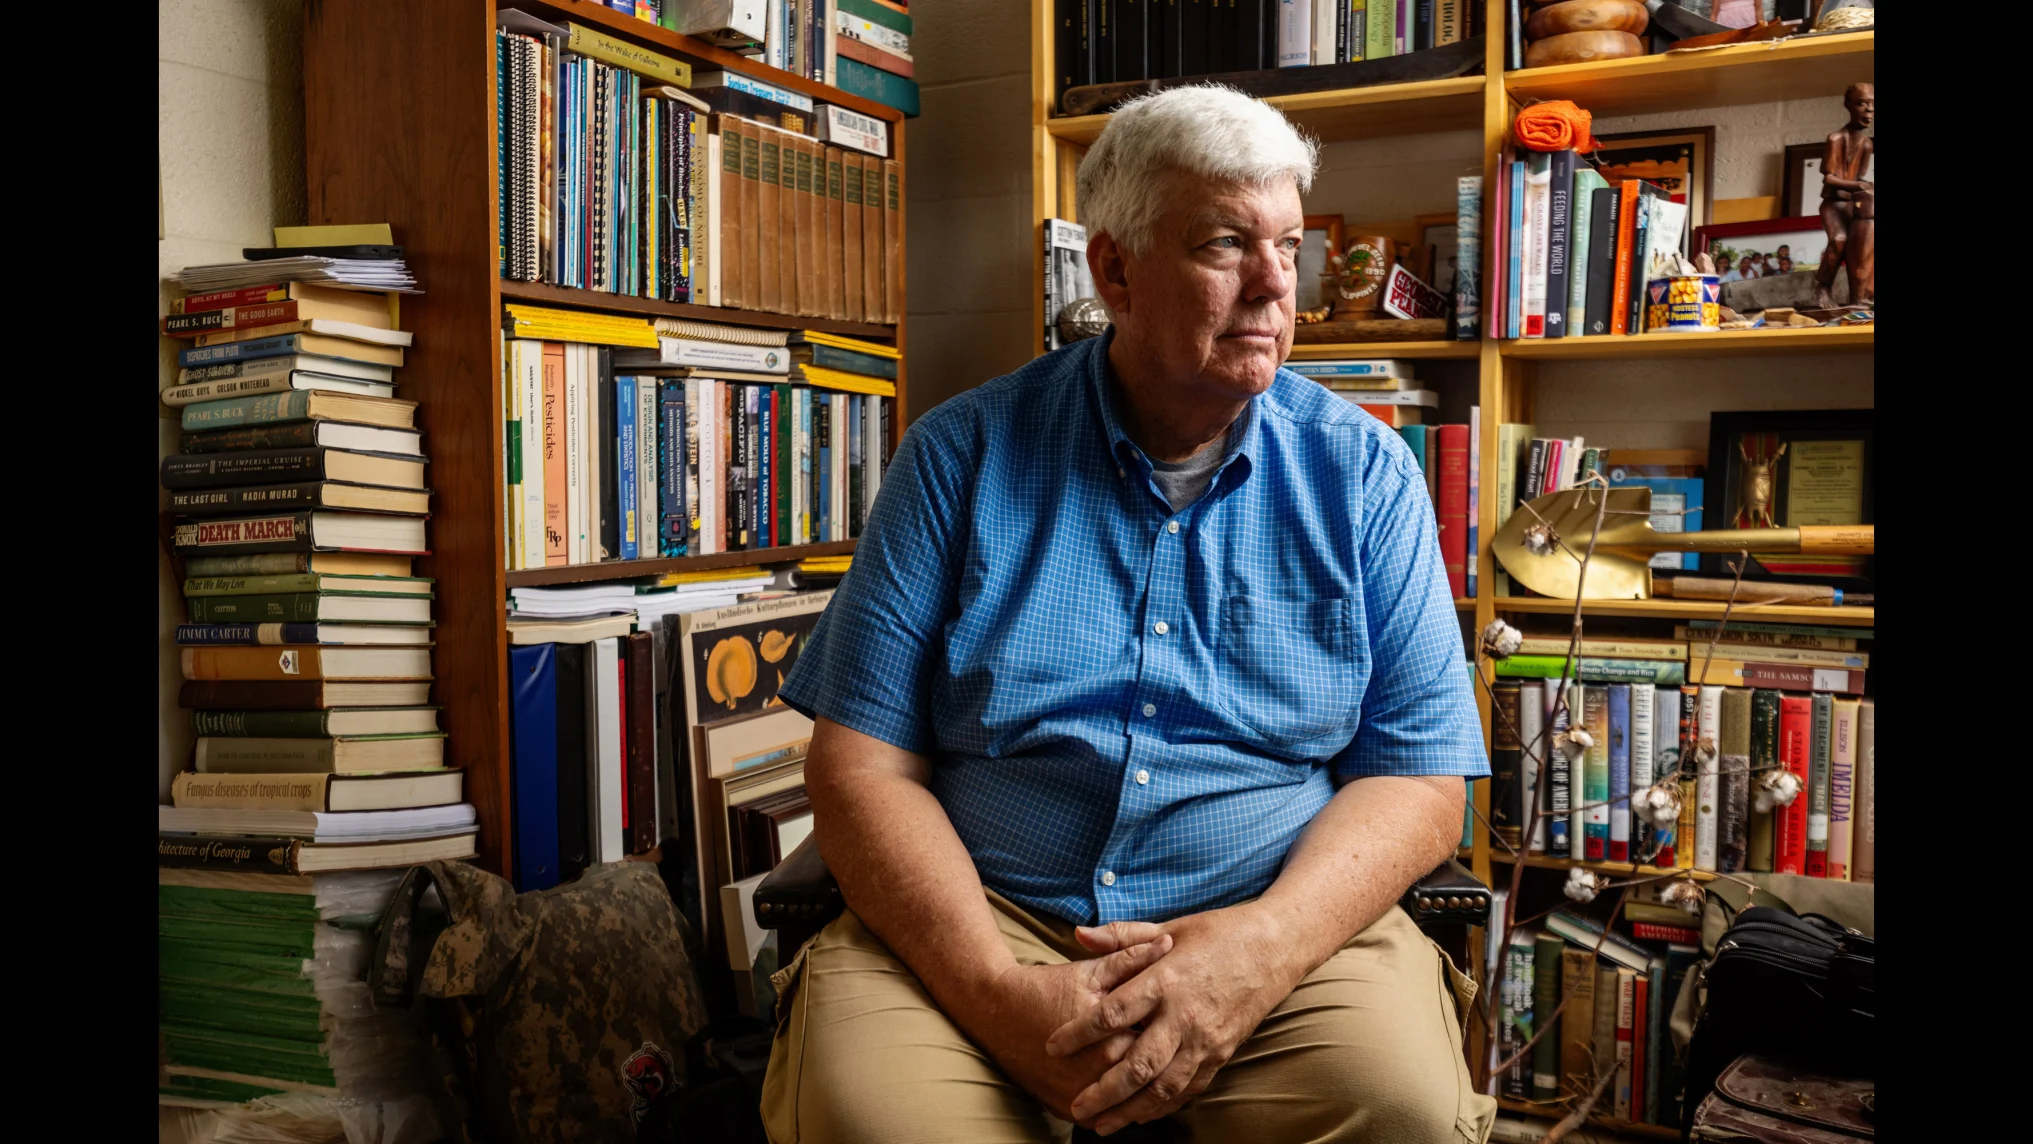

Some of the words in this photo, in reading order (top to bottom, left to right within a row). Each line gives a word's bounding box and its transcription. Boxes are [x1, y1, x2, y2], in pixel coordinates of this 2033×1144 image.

[1420, 2, 1431, 23] Time
[677, 112, 685, 156] Principles
[498, 141, 504, 157] OF
[679, 156, 685, 165] of
[1552, 190, 1567, 226] FEEDING
[1536, 203, 1544, 231] GRAVES
[1551, 227, 1565, 243] THE
[1550, 244, 1564, 275] WORLD
[191, 295, 204, 304] DEVIL
[206, 294, 212, 302] AT
[213, 293, 220, 301] MY
[1618, 281, 1626, 304] HUNGER
[238, 311, 248, 320] THE
[250, 309, 266, 319] GOOD
[267, 307, 285, 317] EARTH
[1672, 304, 1700, 312] HOSTESS
[167, 318, 189, 329] PEARL
[192, 317, 199, 326] S.
[202, 315, 221, 325] BUCK
[1671, 312, 1700, 321] Peanuts
[217, 383, 237, 394] COLSON
[240, 378, 270, 390] WHITEHEAD
[176, 388, 194, 399] NICKEL
[643, 394, 648, 406] OF
[187, 410, 212, 423] PEARL
[214, 409, 222, 419] S.
[222, 407, 244, 418] BUCK
[545, 393, 556, 460] Pesticides
[235, 458, 271, 466] IMPERIAL
[274, 456, 303, 464] CRUISE
[1531, 447, 1541, 475] Barefoot
[629, 473, 634, 483] TO
[763, 466, 768, 476] of
[1528, 475, 1538, 493] Heart
[174, 496, 188, 505] THE
[190, 495, 209, 505] LAST
[210, 493, 228, 503] GIRL
[242, 491, 266, 501] NADIA
[269, 489, 298, 500] MURAD
[175, 524, 198, 535] DONALD
[199, 523, 241, 543] DEATH
[244, 519, 294, 542] MARCH
[175, 533, 198, 546] KNOX
[187, 580, 201, 591] That
[203, 580, 214, 590] We
[215, 579, 230, 591] May
[230, 578, 246, 589] Live
[214, 605, 237, 613] COTTON
[716, 605, 753, 620] Ausländische
[176, 627, 209, 641] JIMMY
[210, 627, 250, 640] CARTER
[757, 631, 763, 643] 5
[1747, 631, 1775, 644] SKIN
[703, 648, 709, 661] 4
[1601, 667, 1627, 676] Change
[1757, 671, 1777, 680] THE
[762, 698, 769, 709] 6
[1636, 689, 1650, 725] SERPENT
[1685, 693, 1694, 713] LOST
[1819, 705, 1828, 717] MY
[1636, 728, 1650, 736] IN
[1839, 719, 1848, 754] ELLISON
[1816, 719, 1827, 774] DETACHMENT
[1635, 740, 1650, 781] PARADISE
[1552, 772, 1569, 784] OF
[1620, 756, 1628, 796] PAINTER
[186, 781, 214, 800] Fungus
[215, 781, 249, 798] diseases
[250, 781, 259, 798] of
[259, 781, 290, 799] tropical
[290, 784, 312, 800] crops
[1728, 781, 1736, 804] Stone
[1815, 784, 1826, 811] TRACY
[1830, 762, 1853, 823] IMELDA
[1728, 805, 1739, 813] of
[1727, 814, 1740, 844] Heaven
[199, 841, 213, 862] of
[212, 843, 250, 864] Georgia
[1640, 923, 1679, 933] STEPHEN
[1640, 931, 1686, 942] AMBROSE
[1514, 953, 1524, 966] of
[1523, 953, 1534, 1009] handbook
[1623, 981, 1632, 998] WAR
[1622, 1002, 1632, 1029] TRASH
[1504, 1007, 1515, 1042] fishes
